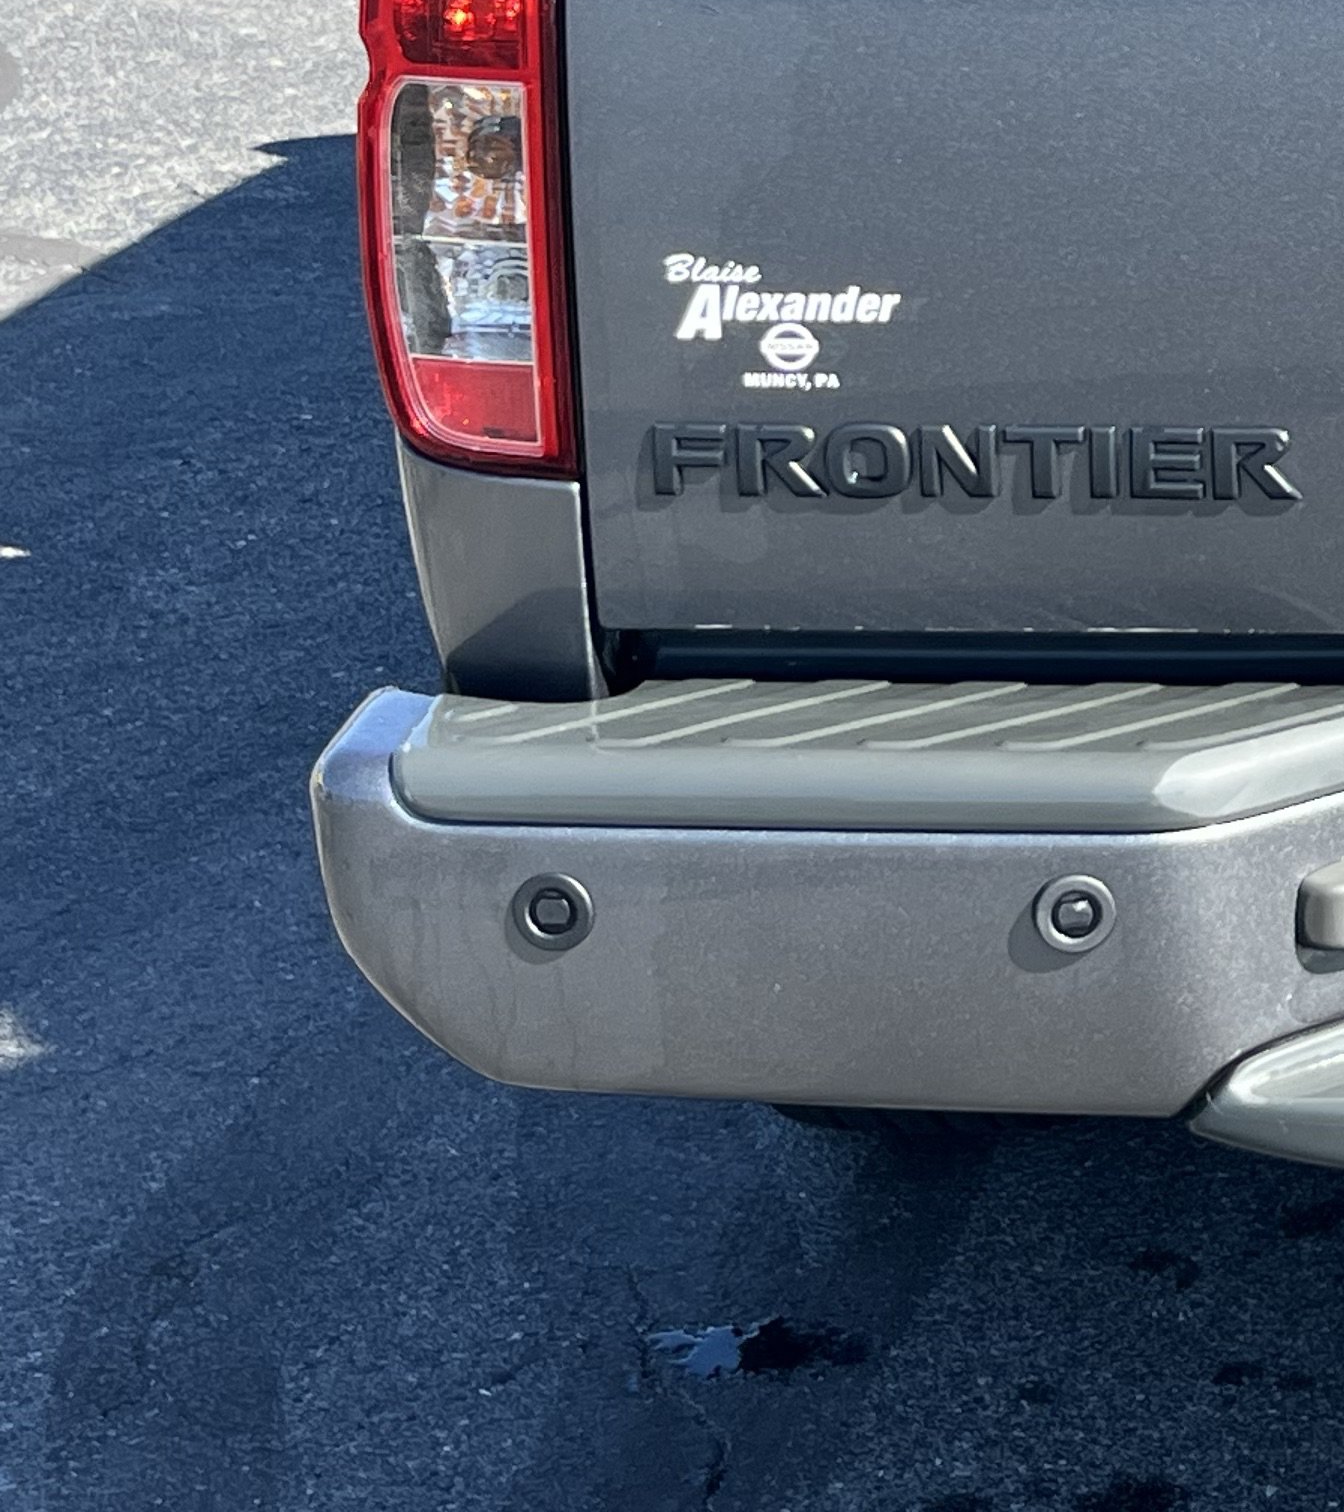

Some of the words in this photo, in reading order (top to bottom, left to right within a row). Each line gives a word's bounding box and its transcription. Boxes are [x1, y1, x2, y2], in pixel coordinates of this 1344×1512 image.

[663, 252, 762, 284] Blaise
[675, 283, 901, 340] Alexander
[742, 372, 811, 391] MUNCY,
[814, 372, 841, 389] PA
[651, 423, 1302, 498] FRONTIER
